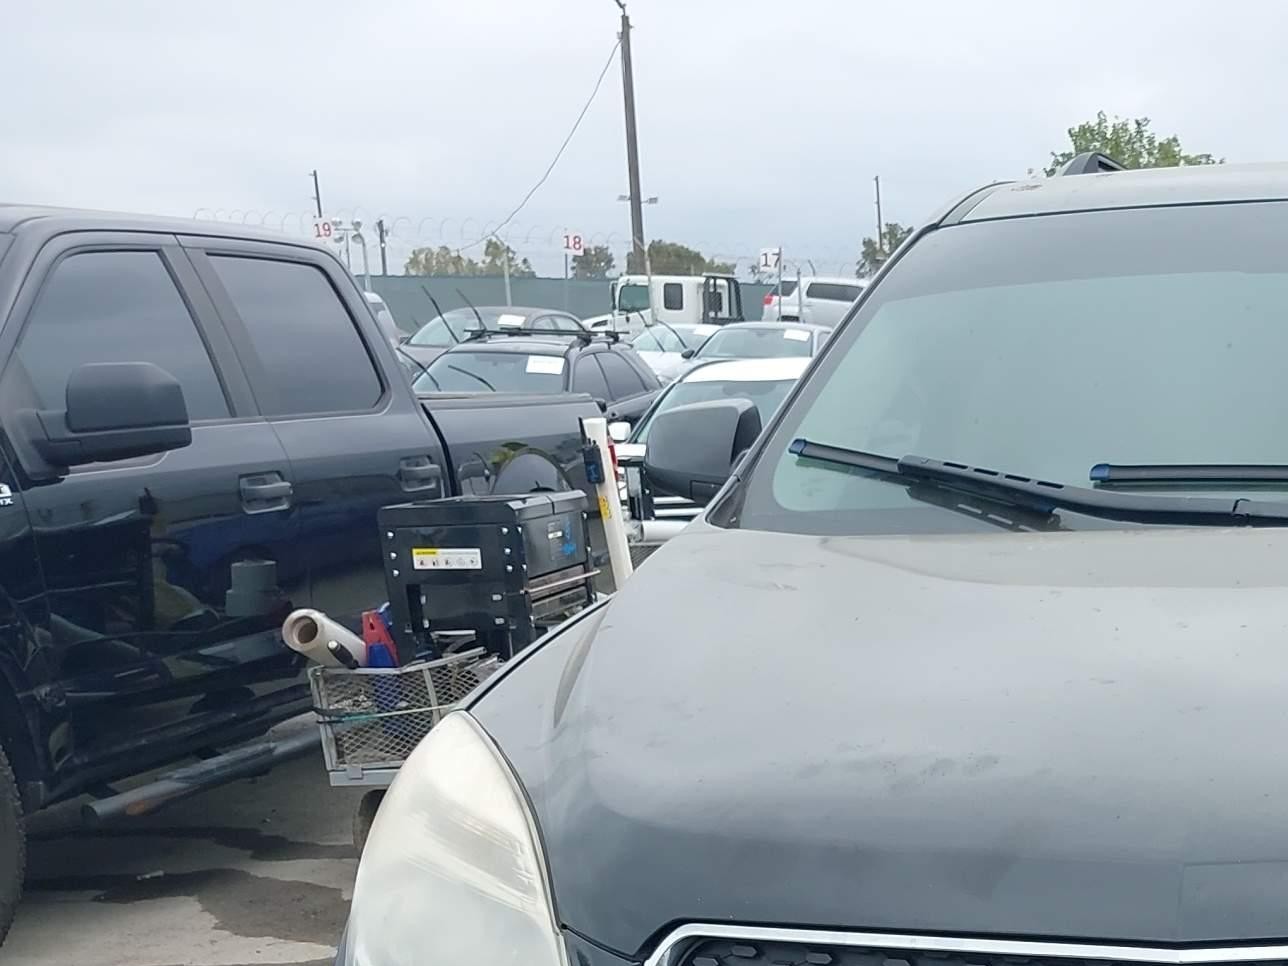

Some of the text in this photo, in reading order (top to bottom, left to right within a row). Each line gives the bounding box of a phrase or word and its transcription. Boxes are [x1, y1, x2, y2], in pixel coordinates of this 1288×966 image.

[314, 222, 332, 238] 19
[563, 235, 582, 251] 18
[761, 252, 781, 268] 17
